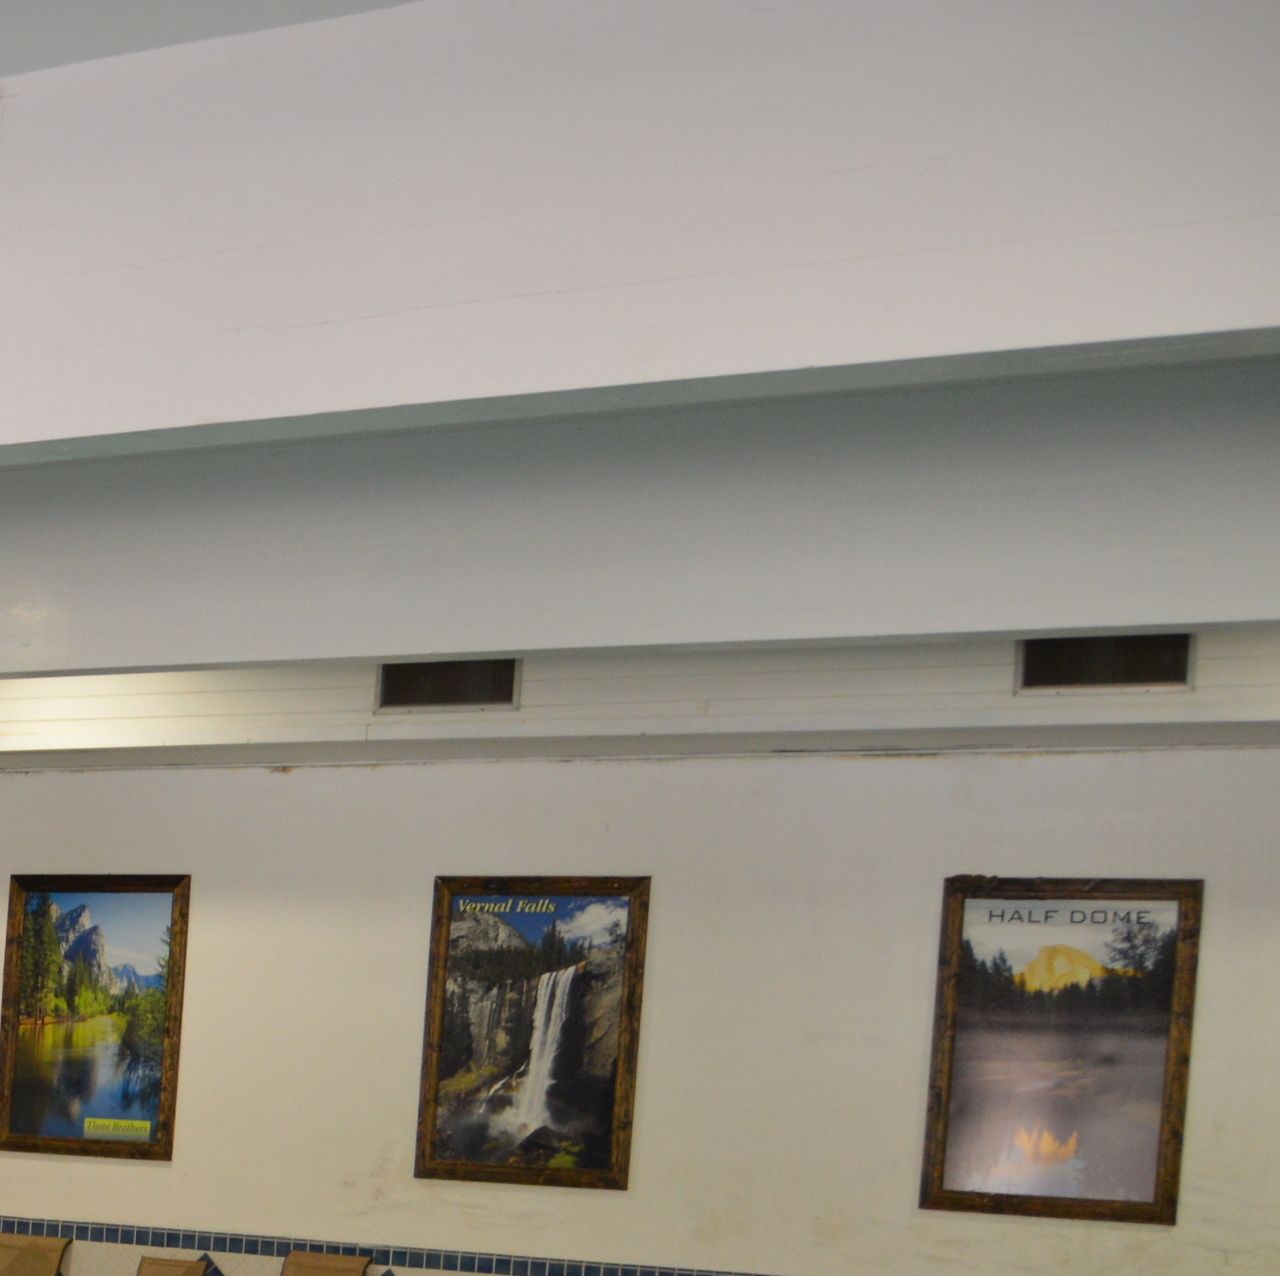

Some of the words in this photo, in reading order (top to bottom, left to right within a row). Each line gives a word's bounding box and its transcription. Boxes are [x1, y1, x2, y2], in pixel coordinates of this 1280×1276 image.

[459, 898, 513, 913] Vernal
[515, 898, 557, 913] Falls
[988, 909, 1059, 924] HALF
[1069, 910, 1153, 925] DOME
[86, 1120, 111, 1132] Three
